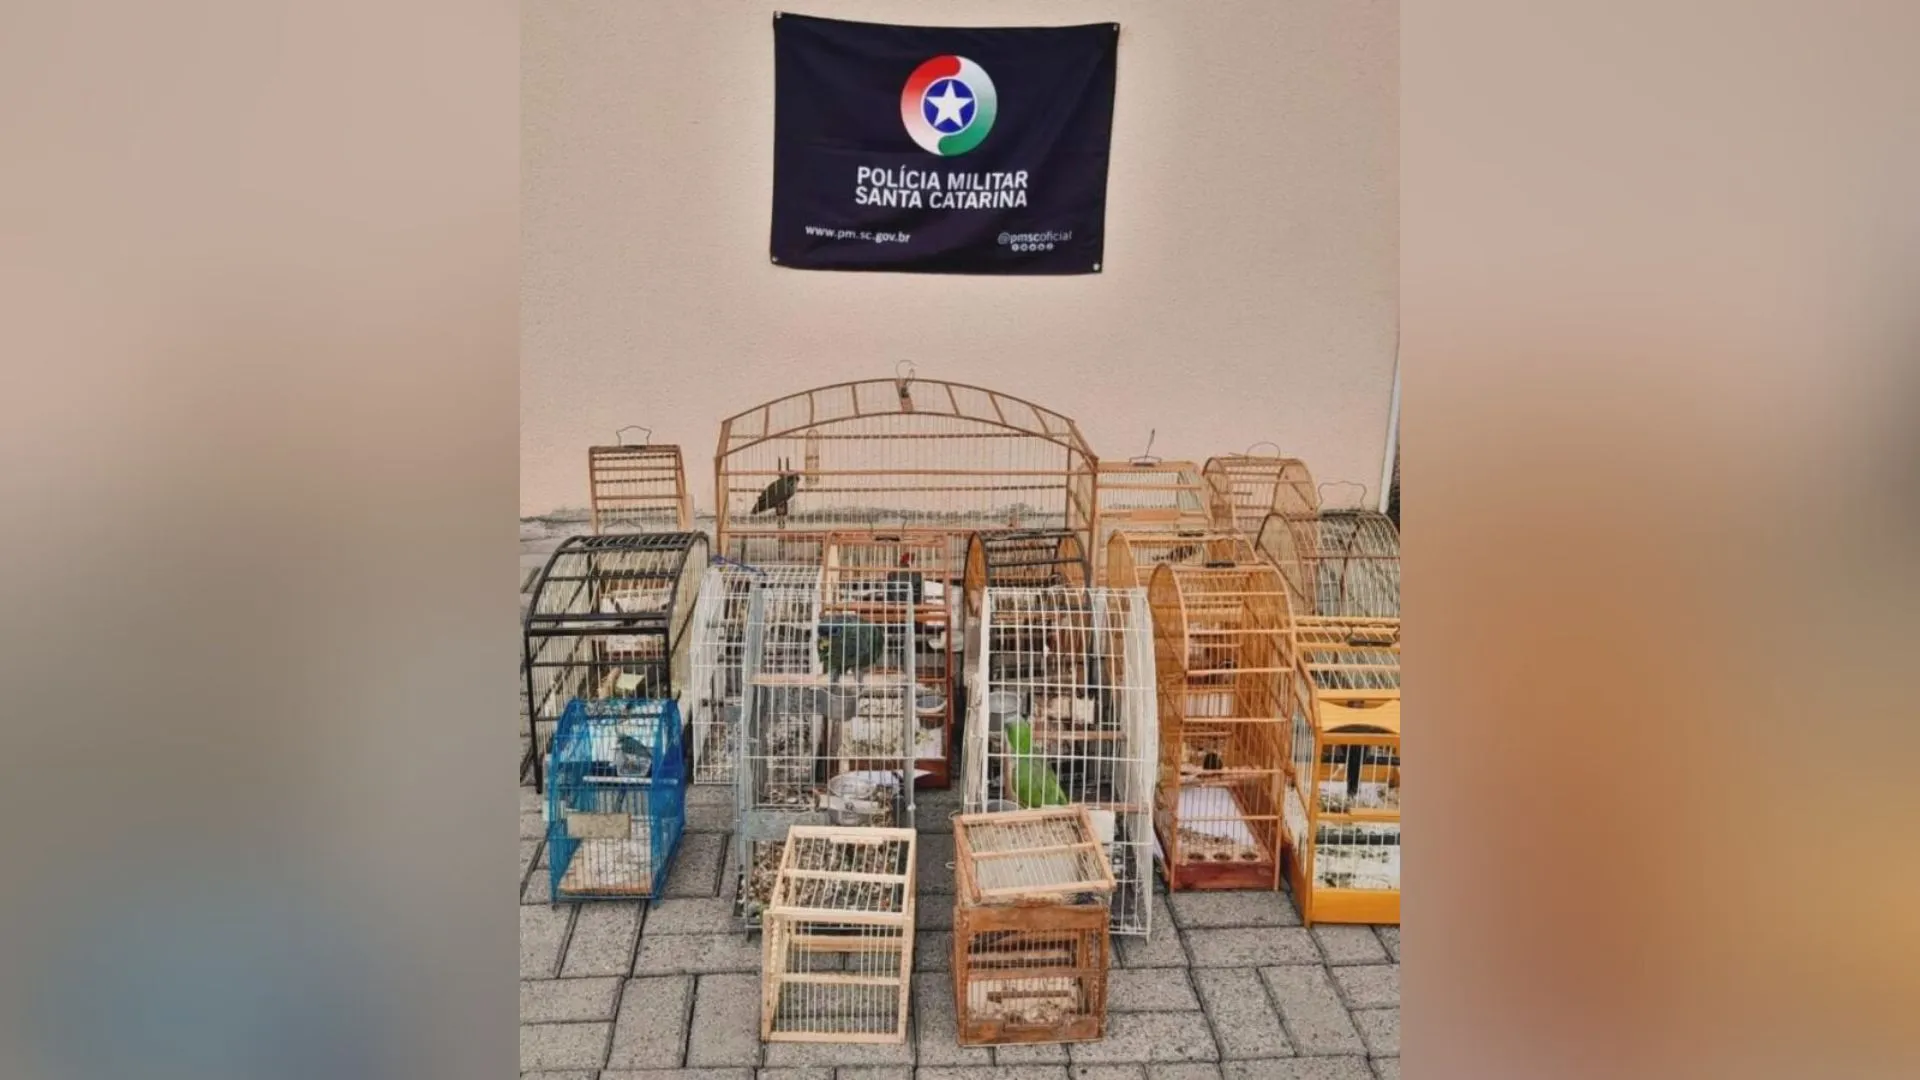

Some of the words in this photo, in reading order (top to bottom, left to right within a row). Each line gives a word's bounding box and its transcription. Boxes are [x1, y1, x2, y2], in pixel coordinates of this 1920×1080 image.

[857, 165, 941, 190] POLÍCIA
[948, 171, 1028, 190] MILITAR
[855, 187, 922, 208] SANTA
[929, 191, 1027, 209] CATARINA
[805, 225, 911, 243] www.pm.sc.gov.br
[997, 230, 1072, 244] @pmscoficial
